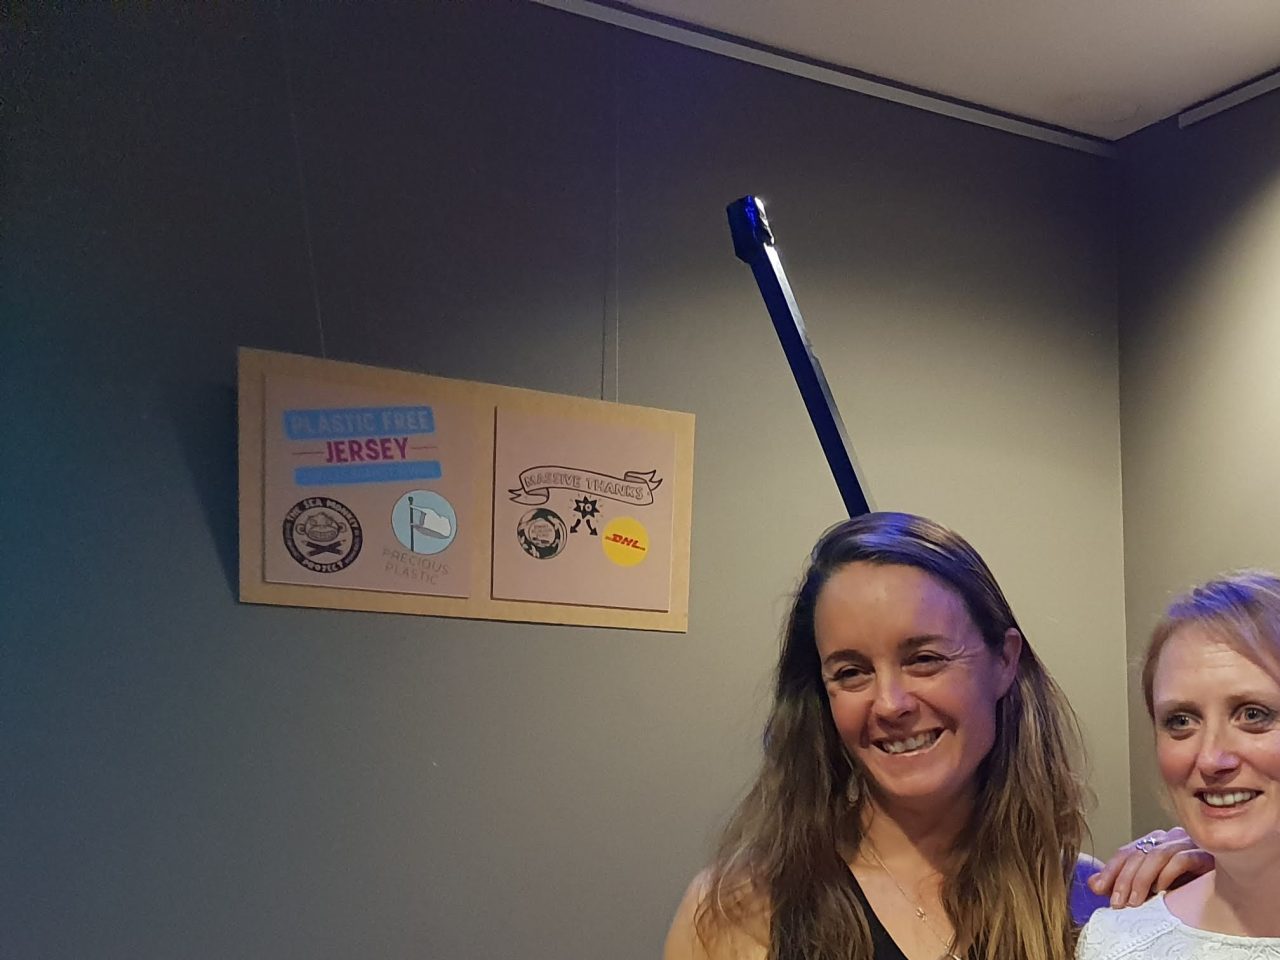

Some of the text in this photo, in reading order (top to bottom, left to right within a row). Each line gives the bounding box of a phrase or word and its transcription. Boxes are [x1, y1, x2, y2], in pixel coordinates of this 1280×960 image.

[290, 410, 430, 434] PLASTIC FREE
[326, 437, 408, 463] JERSEY
[524, 473, 644, 499] MASSIVE THANKS
[304, 498, 323, 508] SEA
[326, 500, 359, 528] MONKEY
[579, 502, 592, 511] TO
[609, 533, 642, 549] DHL
[302, 558, 344, 572] PROJECT
[382, 547, 450, 576] PRECIOUS
[385, 563, 440, 586] PLASTIC
